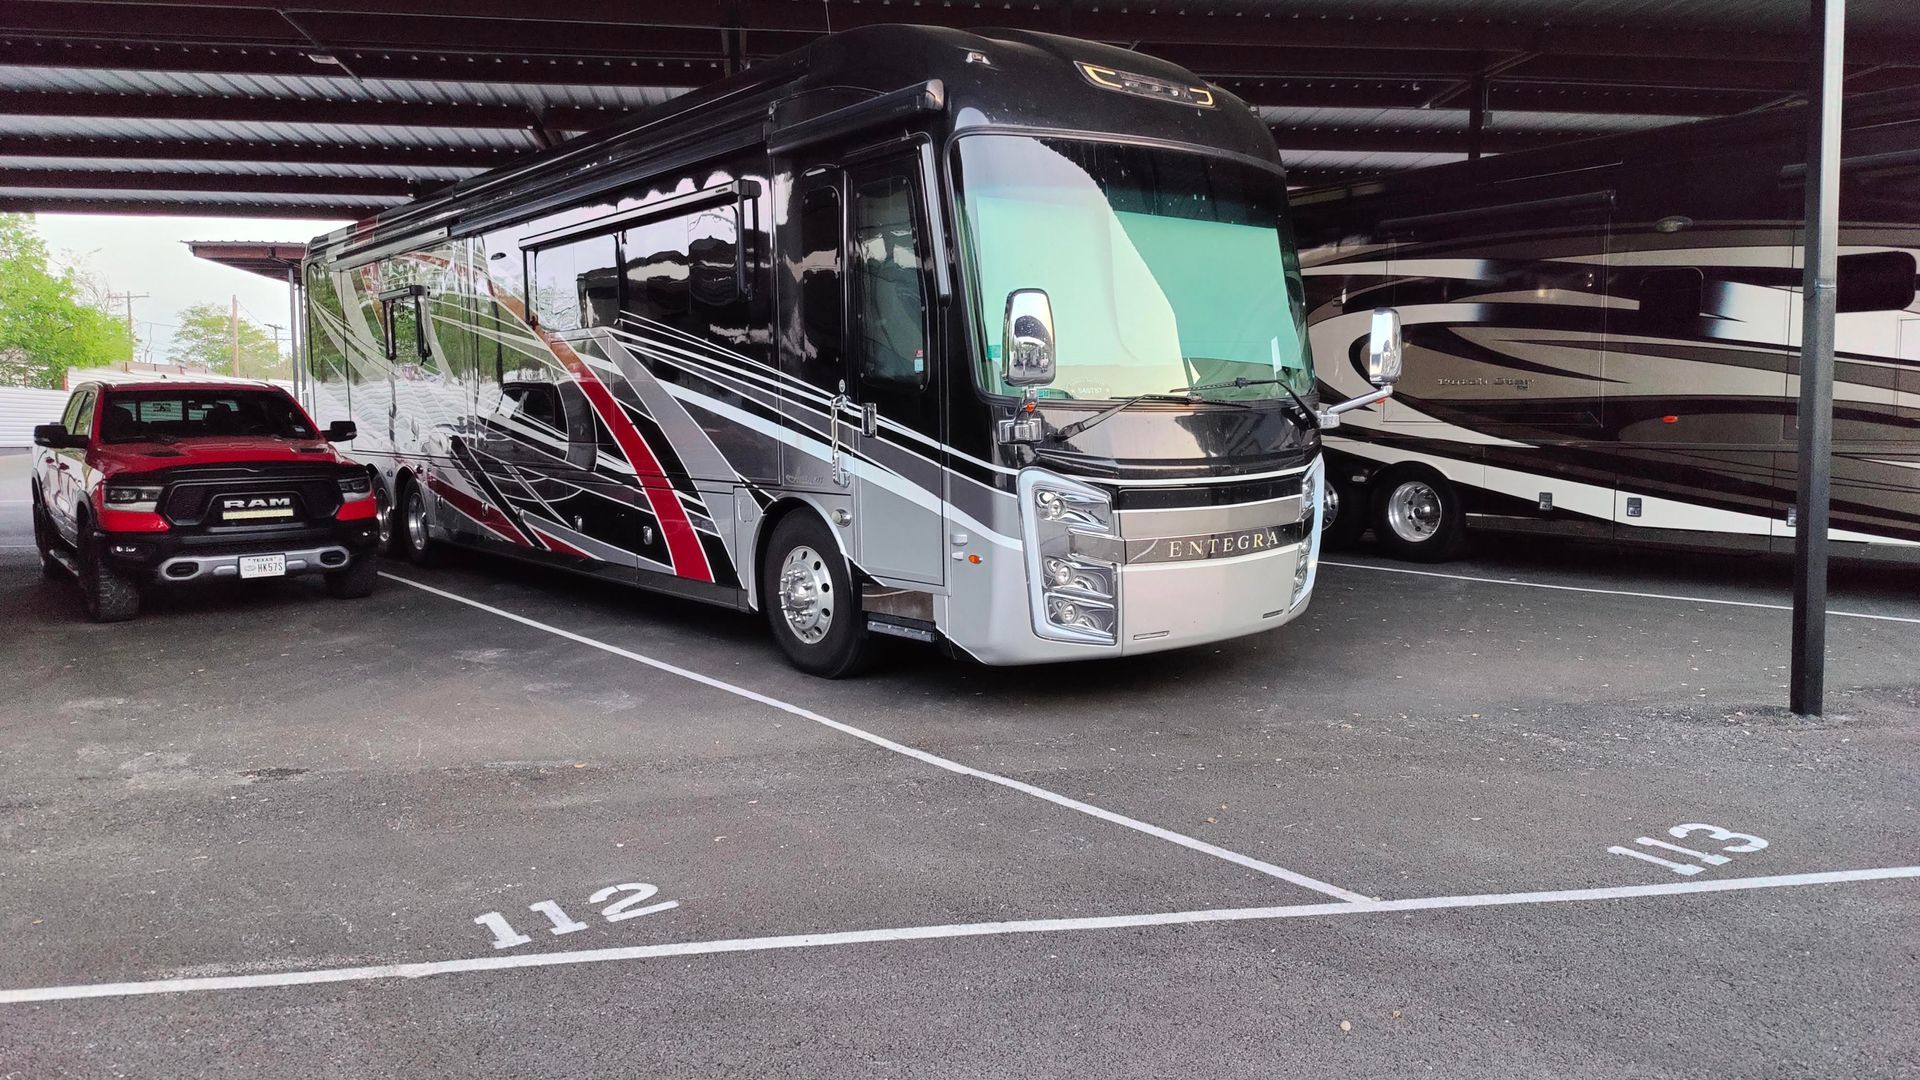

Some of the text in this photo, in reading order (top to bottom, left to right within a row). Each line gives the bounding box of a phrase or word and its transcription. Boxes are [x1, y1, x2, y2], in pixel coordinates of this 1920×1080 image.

[224, 498, 290, 508] RAM
[1168, 531, 1279, 558] ENTEGRA
[1607, 823, 1769, 876] 113
[474, 883, 679, 949] 112
